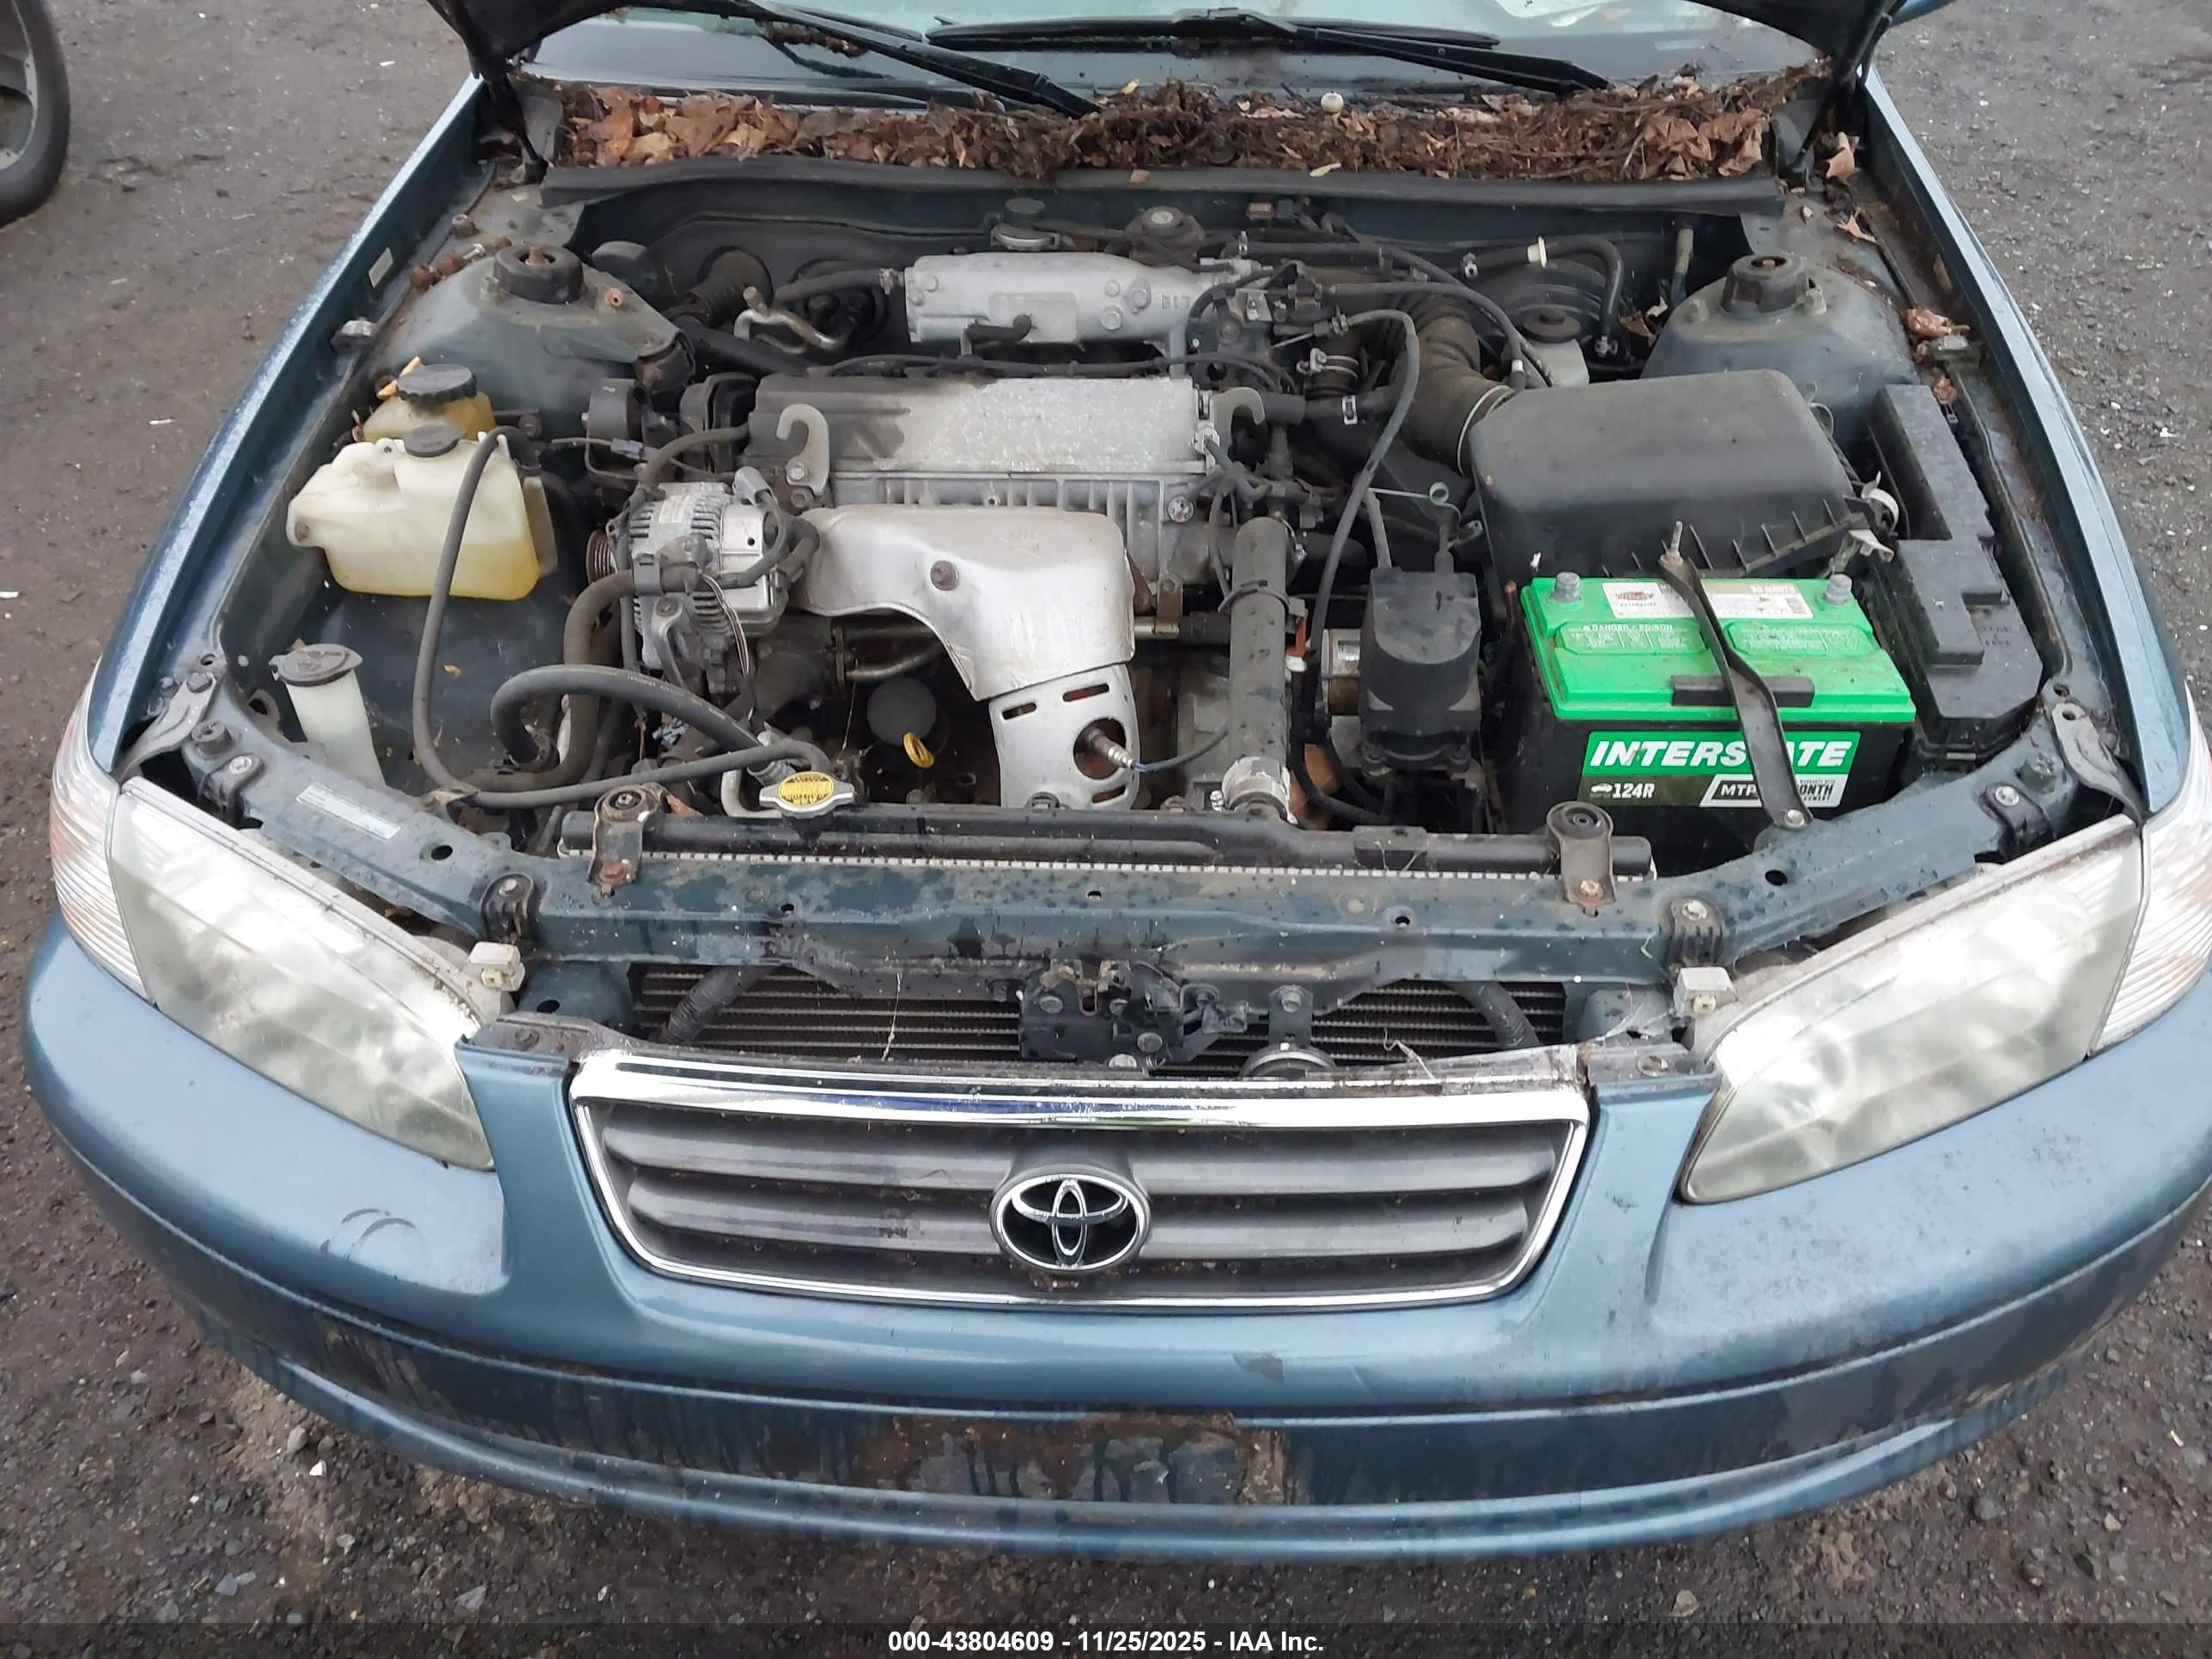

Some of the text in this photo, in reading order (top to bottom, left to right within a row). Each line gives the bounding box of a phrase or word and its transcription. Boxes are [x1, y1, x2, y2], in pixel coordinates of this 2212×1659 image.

[1590, 740, 1852, 767] INTERSTE
[1613, 783, 1656, 799] 124R
[1798, 784, 1834, 795] ONTH
